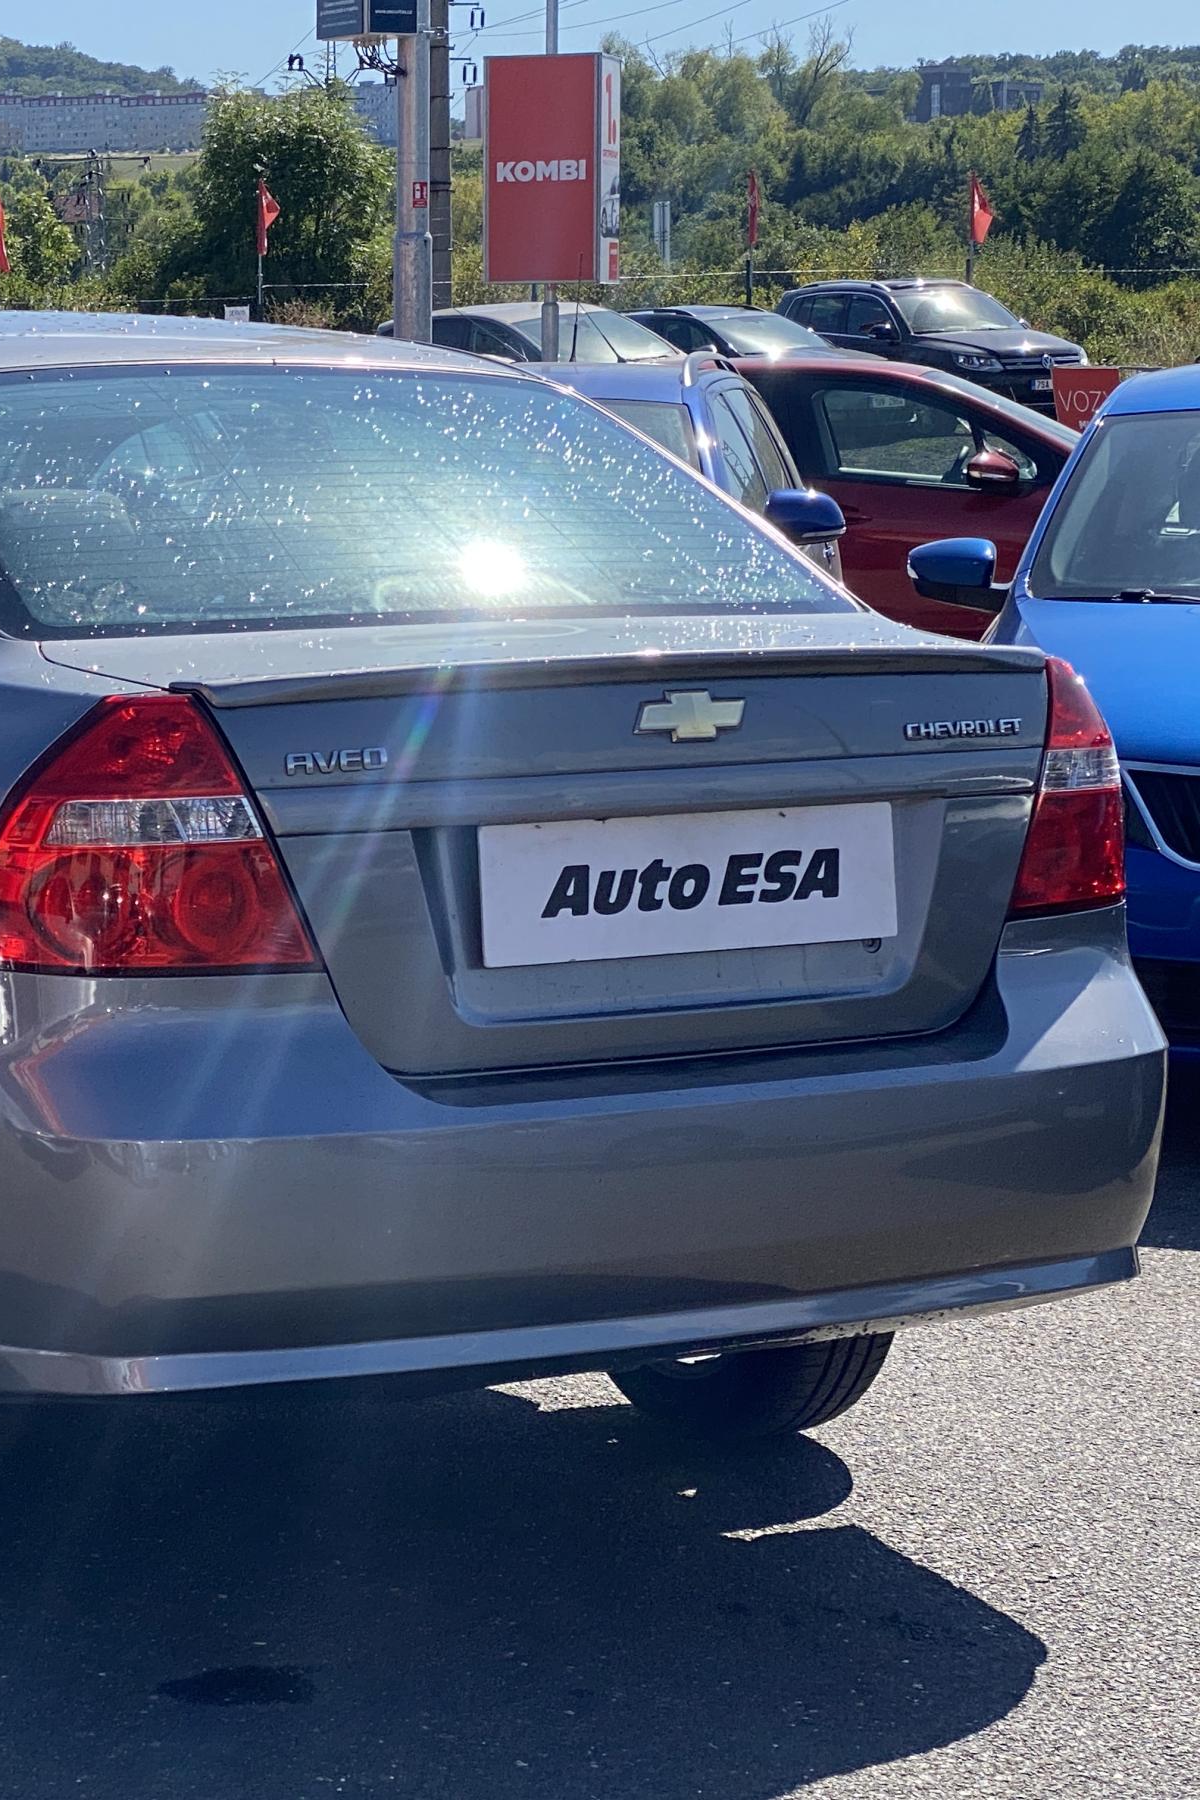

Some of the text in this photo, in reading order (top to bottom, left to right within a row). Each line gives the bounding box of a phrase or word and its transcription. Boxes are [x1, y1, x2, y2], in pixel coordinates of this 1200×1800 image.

[496, 159, 586, 182] KOMBI
[1058, 390, 1107, 412] VOZ
[903, 717, 1022, 741] CHEVROLET
[285, 747, 388, 776] AVEO
[541, 847, 840, 918] Auto ESA
